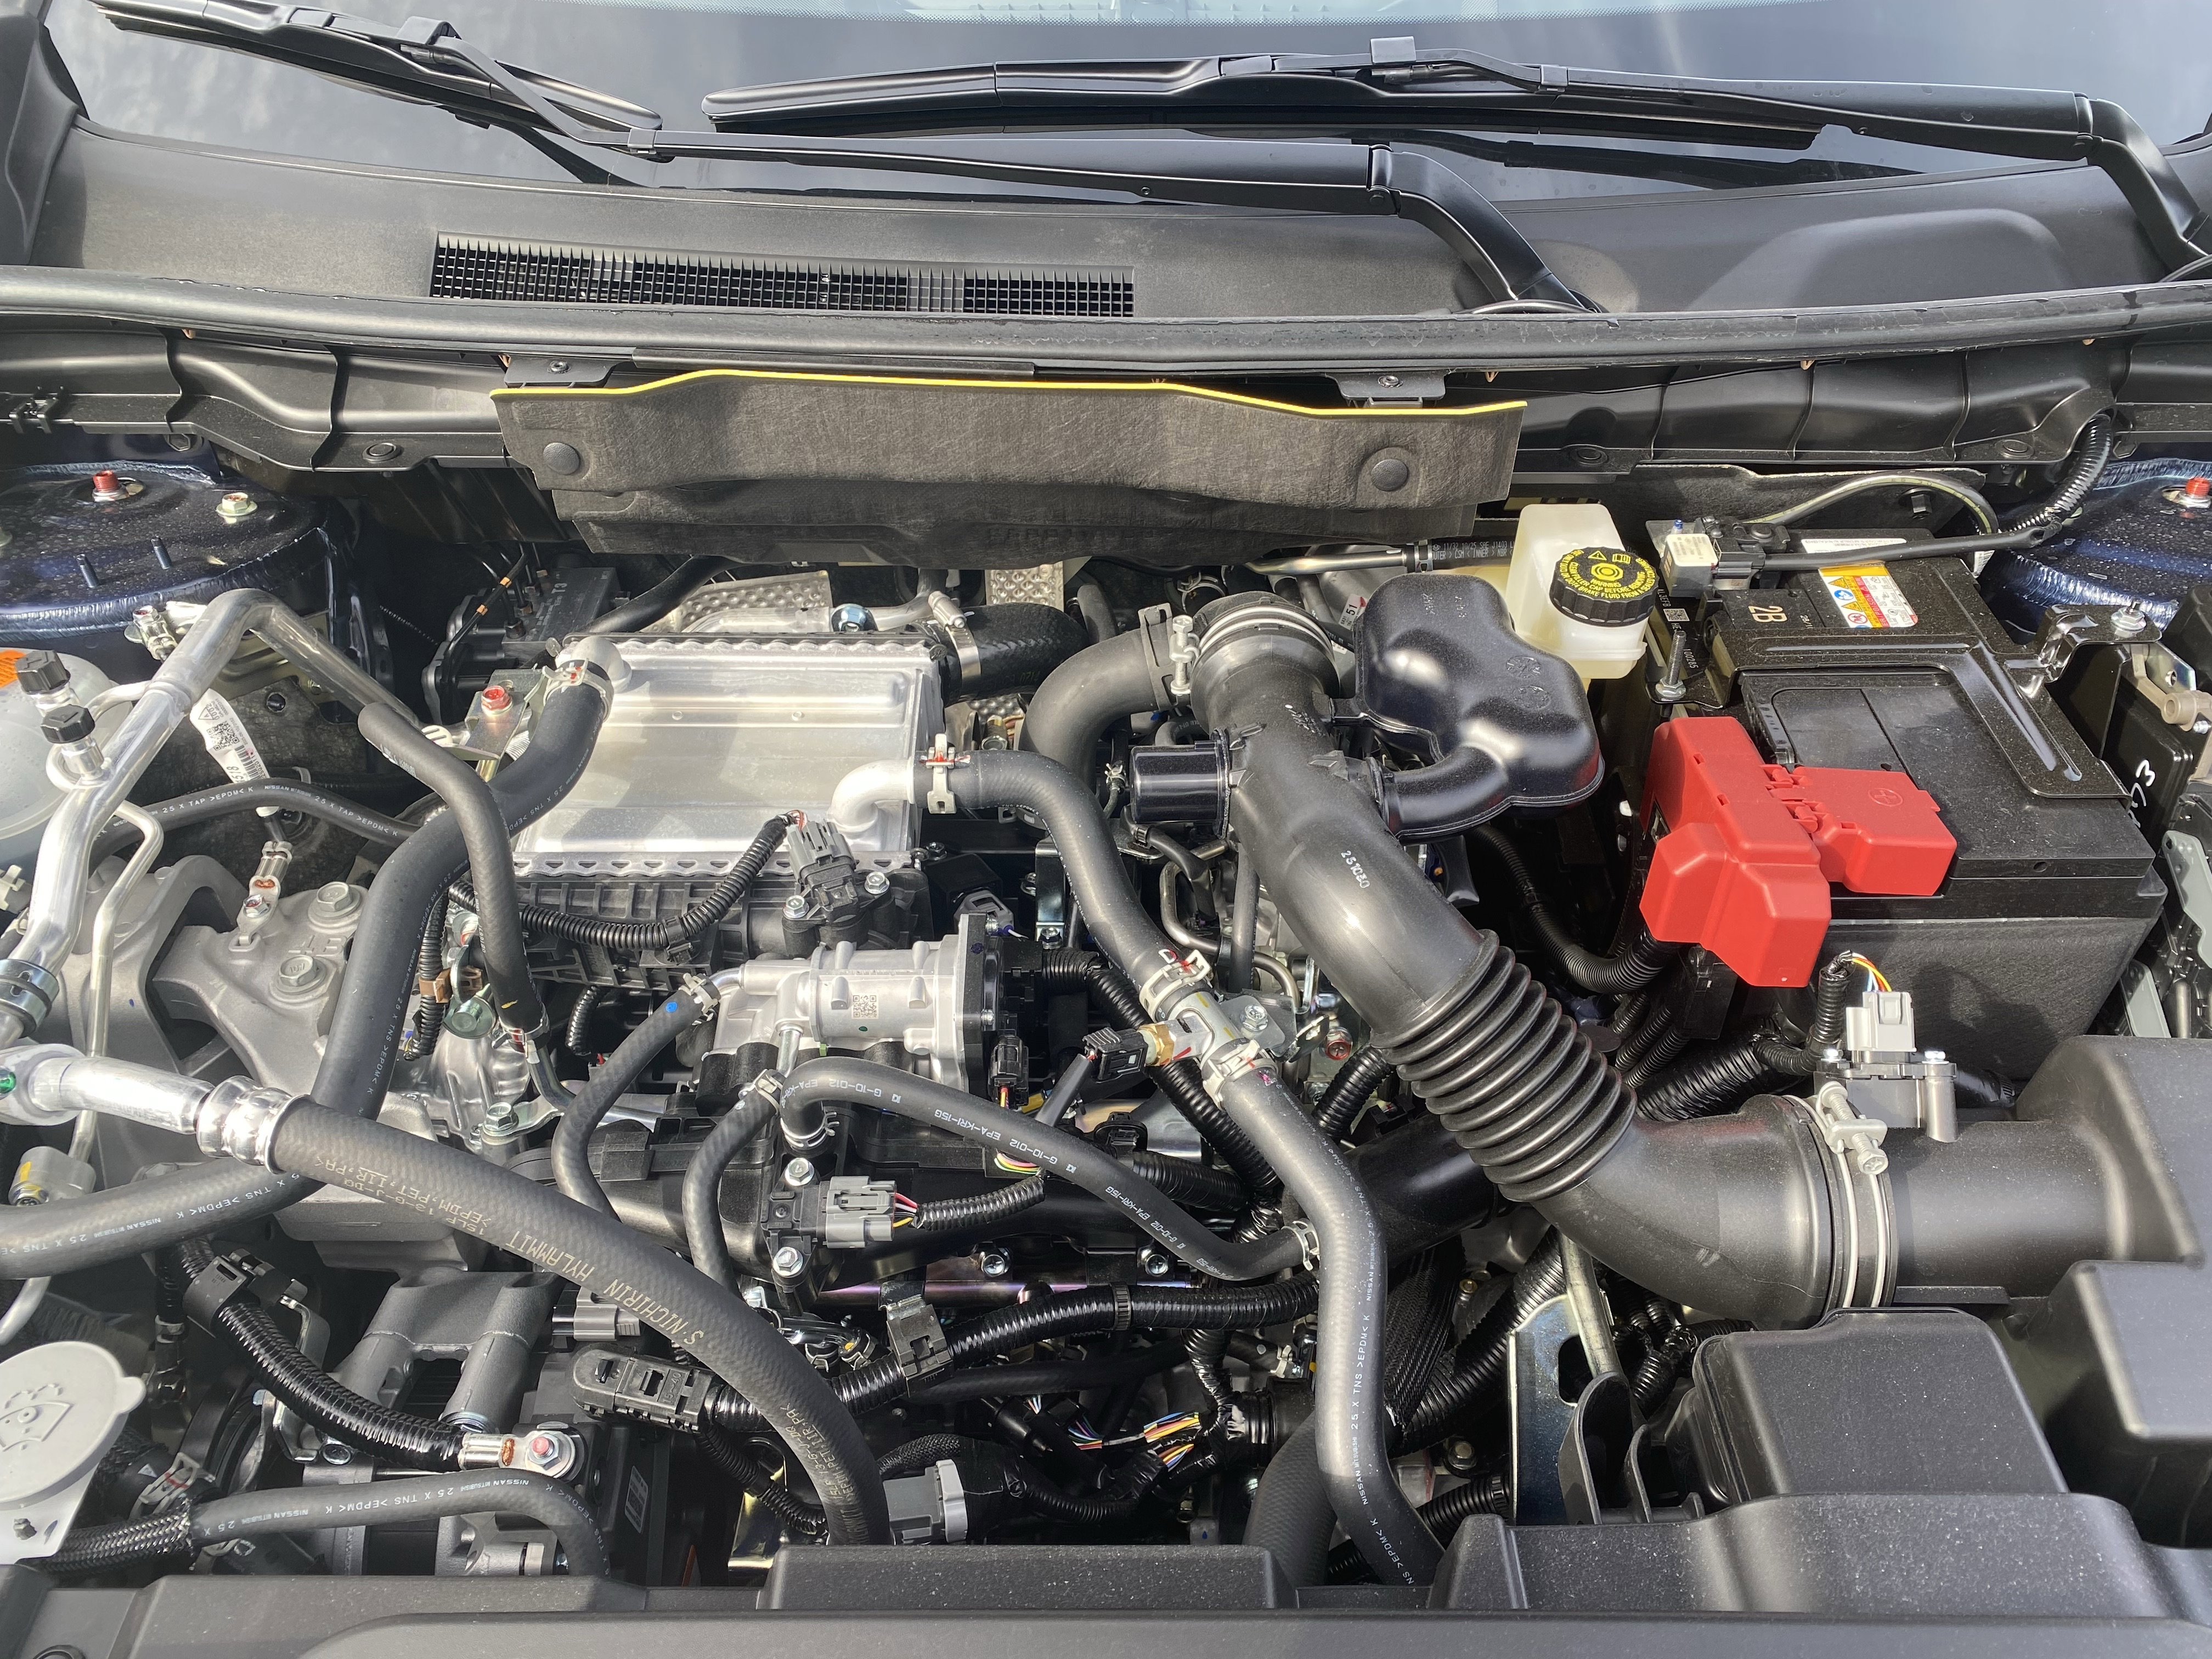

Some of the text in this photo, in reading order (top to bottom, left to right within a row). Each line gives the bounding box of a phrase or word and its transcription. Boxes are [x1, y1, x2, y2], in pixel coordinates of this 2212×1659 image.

[1473, 549, 1488, 558] INNER
[1578, 585, 1599, 597] BRAKE
[1621, 590, 1640, 599] FROM
[1644, 578, 1655, 592] SEALED
[1590, 579, 1622, 588] WARNING
[1346, 604, 1357, 616] 51
[1748, 606, 1787, 623] 2B
[1683, 648, 1699, 669] 100285
[189, 798, 206, 808] TAP
[209, 788, 244, 802] >EPDM<
[314, 795, 326, 804] 25
[338, 806, 353, 817] TAP
[357, 815, 389, 833] >EPDM<
[531, 804, 544, 815] TNS
[509, 816, 527, 831] >EPD
[409, 948, 417, 972] NISSAN
[386, 1023, 396, 1042] TNS
[371, 1045, 388, 1085] >EPDM<
[829, 1079, 882, 1097] G-10-012
[934, 1109, 1001, 1141] EPA-KRI-15G
[1009, 1138, 1058, 1165] G-10-012
[245, 1187, 272, 1200] TNS
[1355, 1186, 1367, 1205] TNS
[190, 1197, 240, 1216] >EPDM<
[127, 1217, 161, 1230] NISSAN
[1150, 1220, 1177, 1243] G-10-012
[55, 1239, 63, 1248] X
[70, 1234, 86, 1245] 25
[24, 1243, 48, 1253] TNS
[505, 1231, 595, 1282] HYLAMMIT
[1357, 1325, 1369, 1368] >EPDM<
[1353, 1373, 1362, 1394] TNS
[1351, 1414, 1359, 1430] 25
[438, 1487, 454, 1497] 25
[545, 1483, 552, 1491] K
[1356, 1470, 1368, 1505] NISSAN
[394, 1494, 417, 1504] TNS
[425, 1492, 432, 1500] X
[274, 1509, 308, 1520] NISSAN
[325, 1505, 332, 1513] K
[338, 1500, 388, 1513] >EPDM<
[558, 1488, 594, 1525] >EPDM<
[203, 1527, 211, 1536] X
[218, 1520, 236, 1533] 25
[1370, 1518, 1416, 1591] NS >EPDM< K
